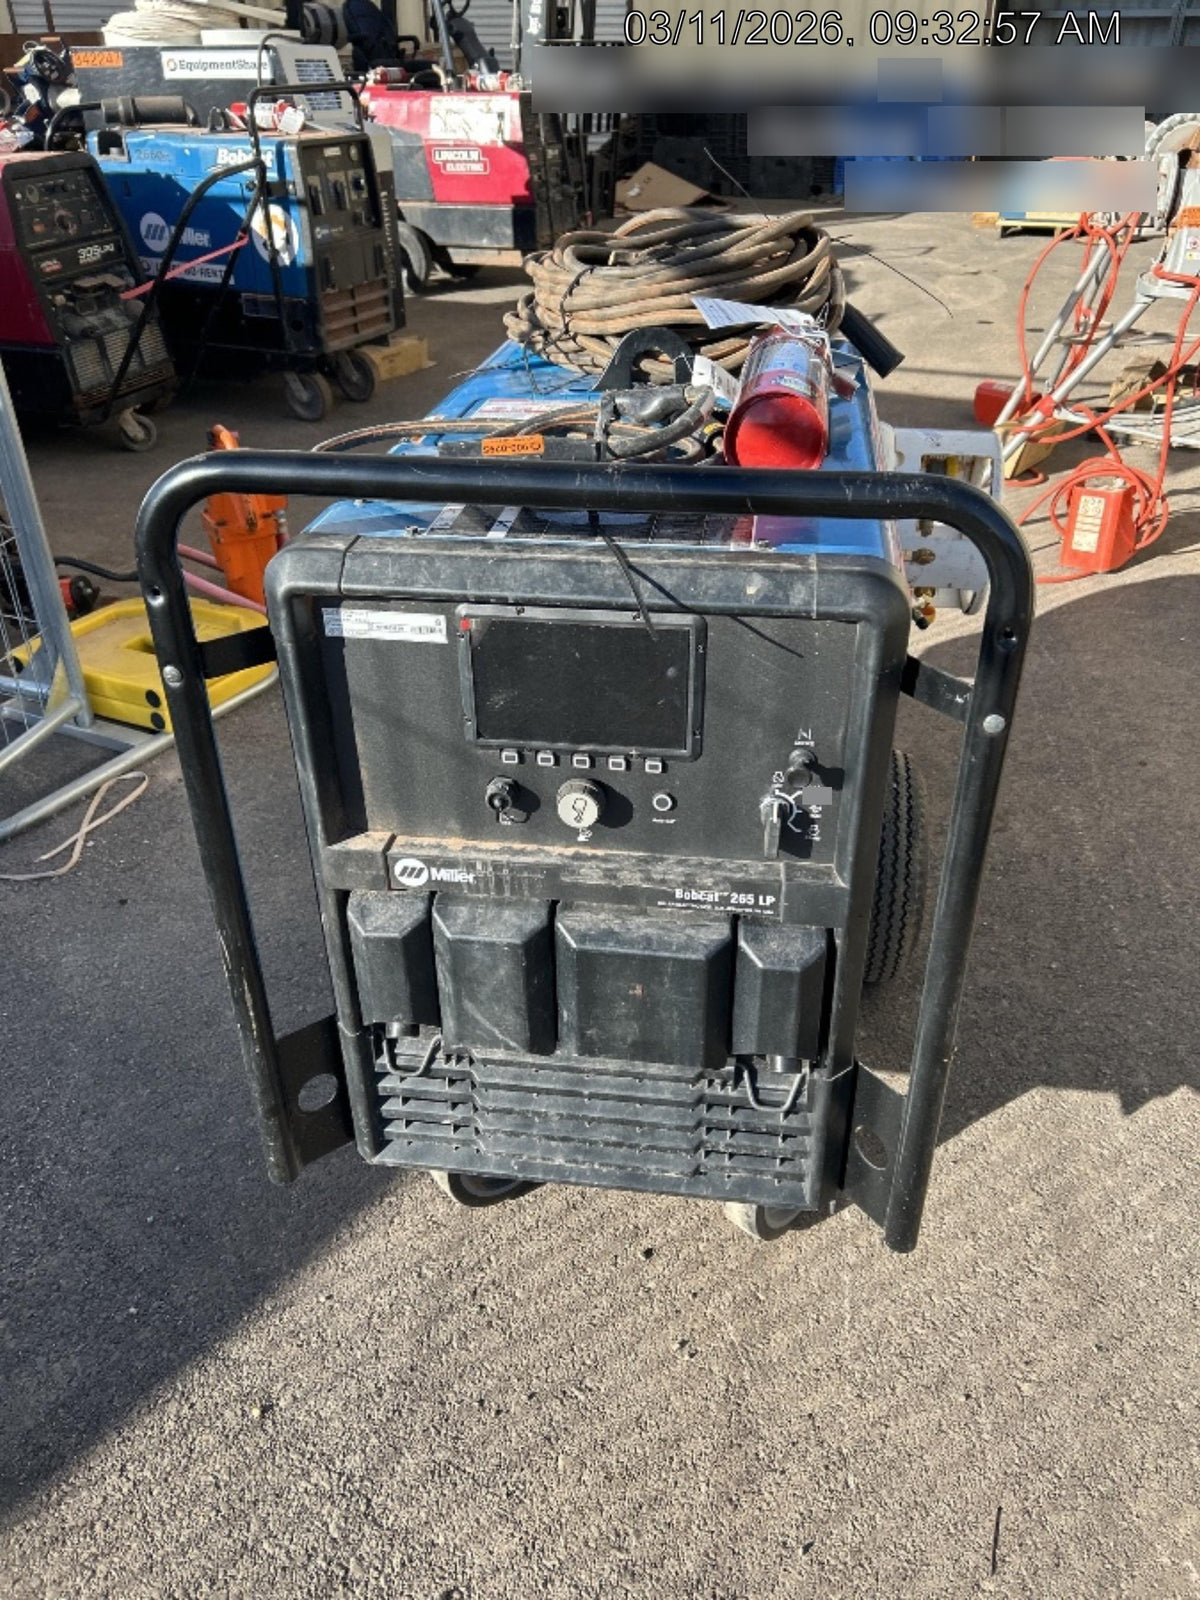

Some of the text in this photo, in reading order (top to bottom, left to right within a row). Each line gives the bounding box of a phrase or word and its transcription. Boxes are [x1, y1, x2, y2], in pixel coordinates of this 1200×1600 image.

[178, 59, 268, 72] EquipmentShae
[216, 147, 273, 168] Bobt
[434, 150, 480, 162] LINCOLN
[430, 866, 476, 884] Miller
[674, 888, 776, 907] Bobcat 265 LP
